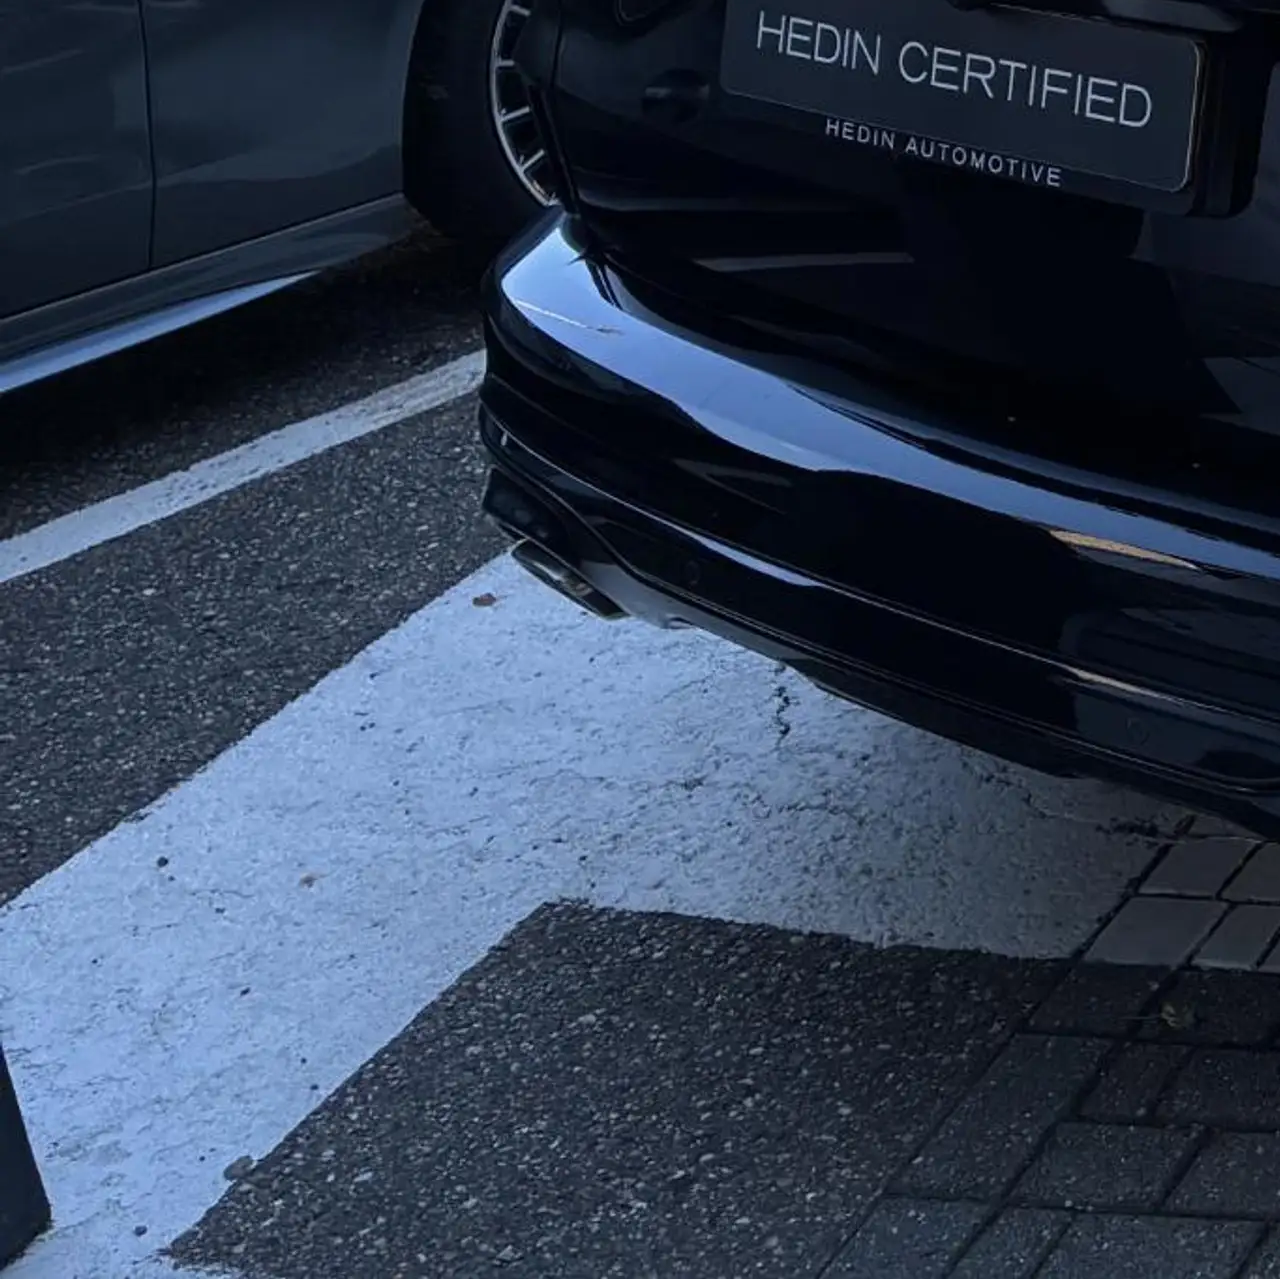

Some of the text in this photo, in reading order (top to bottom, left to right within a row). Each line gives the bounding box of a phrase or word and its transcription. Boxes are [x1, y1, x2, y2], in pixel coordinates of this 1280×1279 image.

[756, 9, 1153, 128] HEDIN CERTIFIED
[825, 118, 1063, 187] HEDIN AUTOMOTIVE
